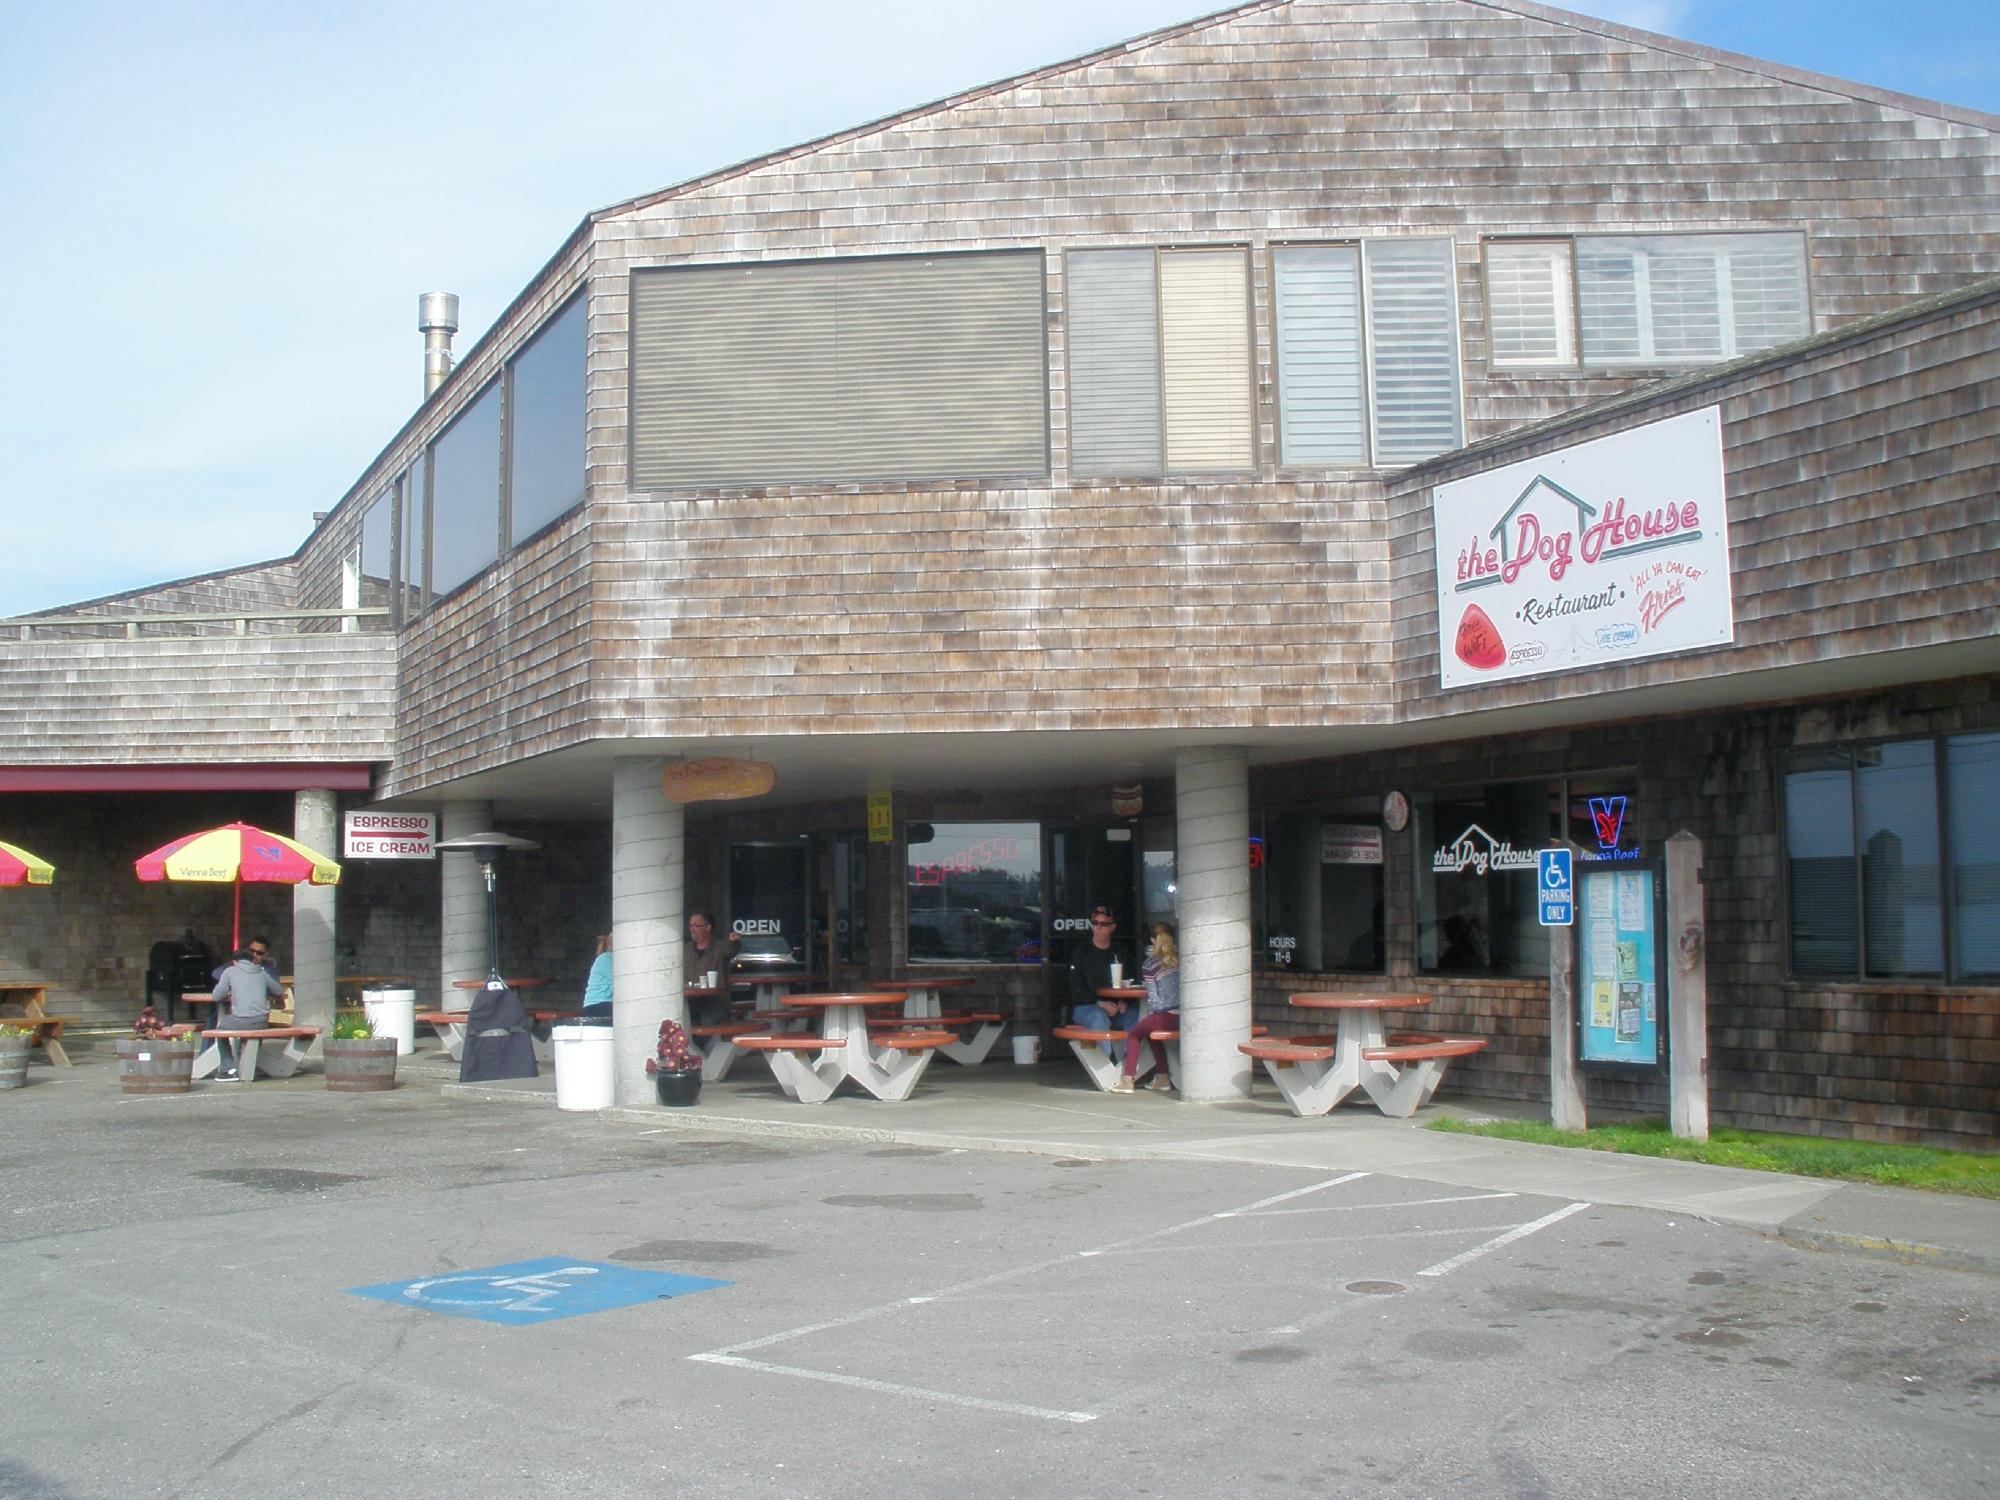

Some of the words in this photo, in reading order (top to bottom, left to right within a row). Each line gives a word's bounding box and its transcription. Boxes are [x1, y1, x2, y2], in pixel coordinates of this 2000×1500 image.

[1456, 536, 1499, 582] the
[1502, 512, 1574, 585] Dog
[1580, 497, 1700, 564] House
[1666, 561, 1684, 574] CAN
[1521, 581, 1617, 626] Restaurant
[1638, 578, 1684, 634] Fries
[1511, 645, 1543, 660] ESPRESSO
[353, 816, 429, 829] ESPRESSO
[351, 842, 374, 853] ICE
[380, 842, 430, 854] CREAM
[914, 837, 1018, 883] ESPRESSO
[1433, 845, 1455, 866] the
[1455, 840, 1488, 875] Dog
[1491, 842, 1540, 870] House
[180, 867, 208, 878] Vienna
[209, 867, 228, 879] Beef
[1541, 888, 1570, 903] PARKING
[1547, 905, 1565, 920] ONLY
[733, 919, 780, 933] OPEN
[1053, 918, 1094, 931] OPEN
[1269, 936, 1297, 949] HOURS
